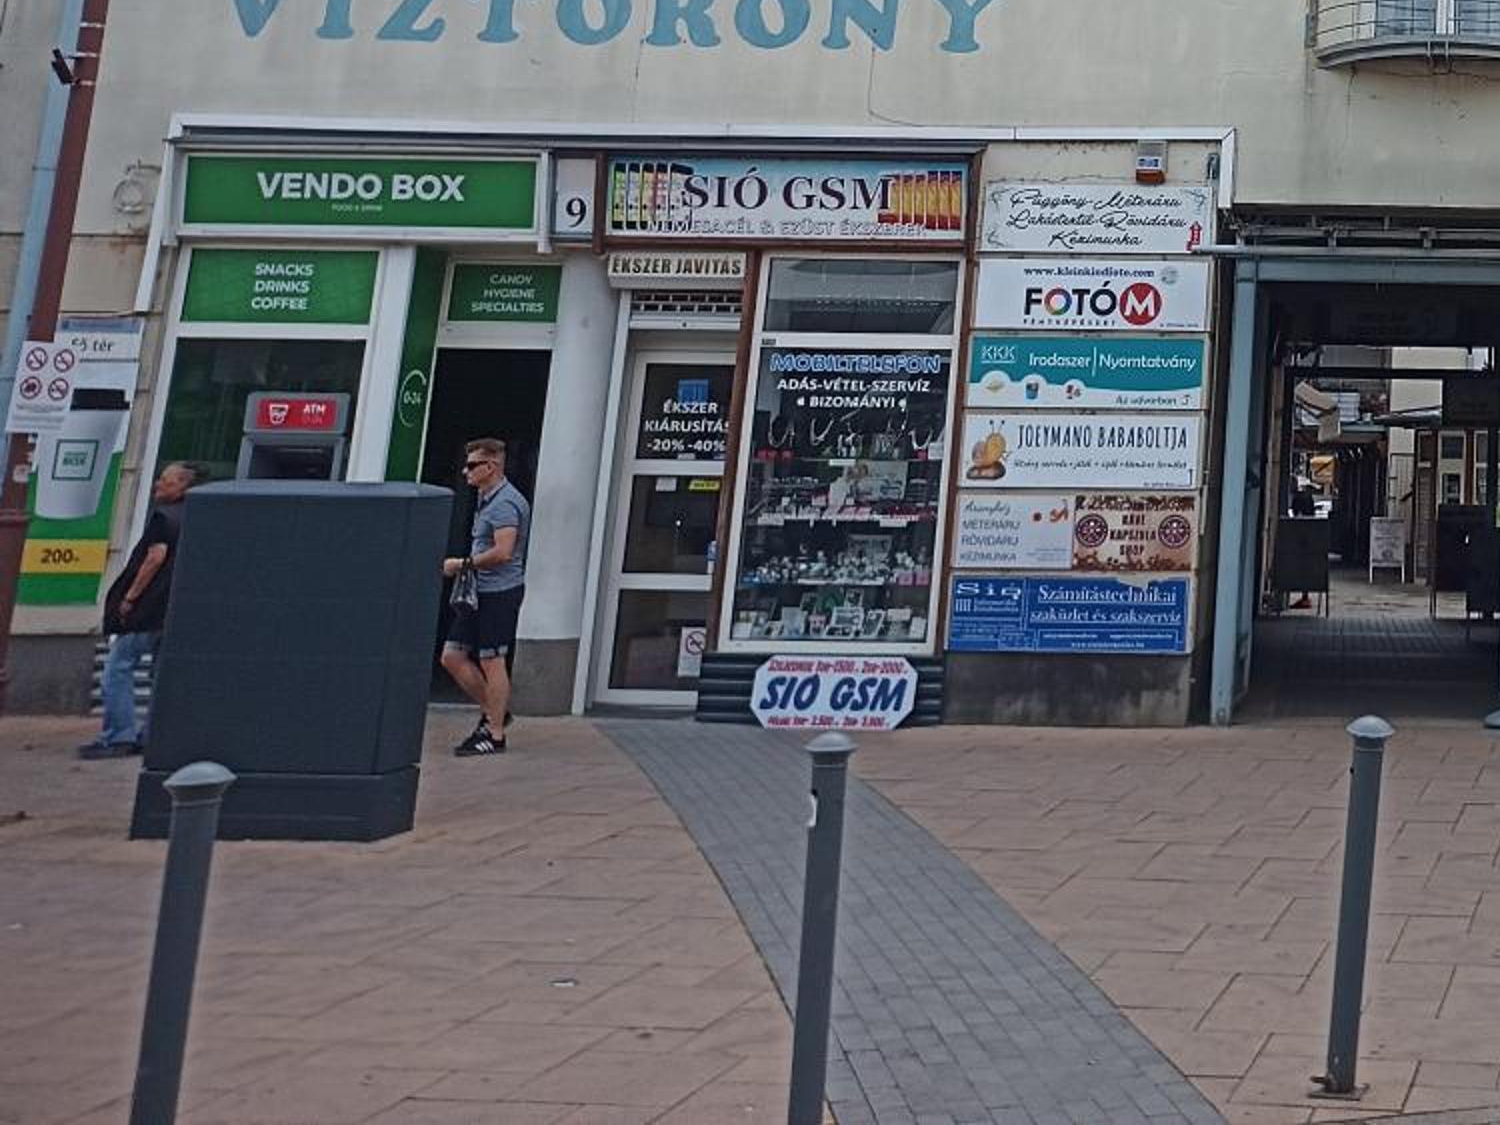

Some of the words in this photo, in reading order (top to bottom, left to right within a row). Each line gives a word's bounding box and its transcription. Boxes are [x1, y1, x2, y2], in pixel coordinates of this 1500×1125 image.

[256, 172, 382, 201] VENDO
[391, 174, 465, 203] BOX
[683, 167, 769, 210] SIÓ
[781, 176, 893, 211] GSM
[565, 196, 587, 228] 9
[255, 263, 314, 276] SNACKS
[254, 279, 311, 293] DRINKS
[489, 274, 533, 286] CANDY
[483, 288, 536, 299] HYGIENE
[251, 296, 308, 310] COFFEE
[471, 301, 545, 313] SPECIALTIES
[981, 345, 1017, 361] KKK
[769, 353, 941, 374] MOBILTELEFON
[1028, 353, 1092, 368] Irodaszer
[1099, 353, 1197, 371] Nyomtatvány
[663, 398, 719, 414] ÉKSZER
[809, 394, 895, 409] BIZOMÁNYI
[303, 403, 326, 416] ATM
[1097, 425, 1188, 450] BABABOLTJA
[647, 439, 685, 452] -20%
[688, 439, 725, 452] -40%
[1091, 608, 1107, 622] és
[829, 677, 909, 712] GSM
